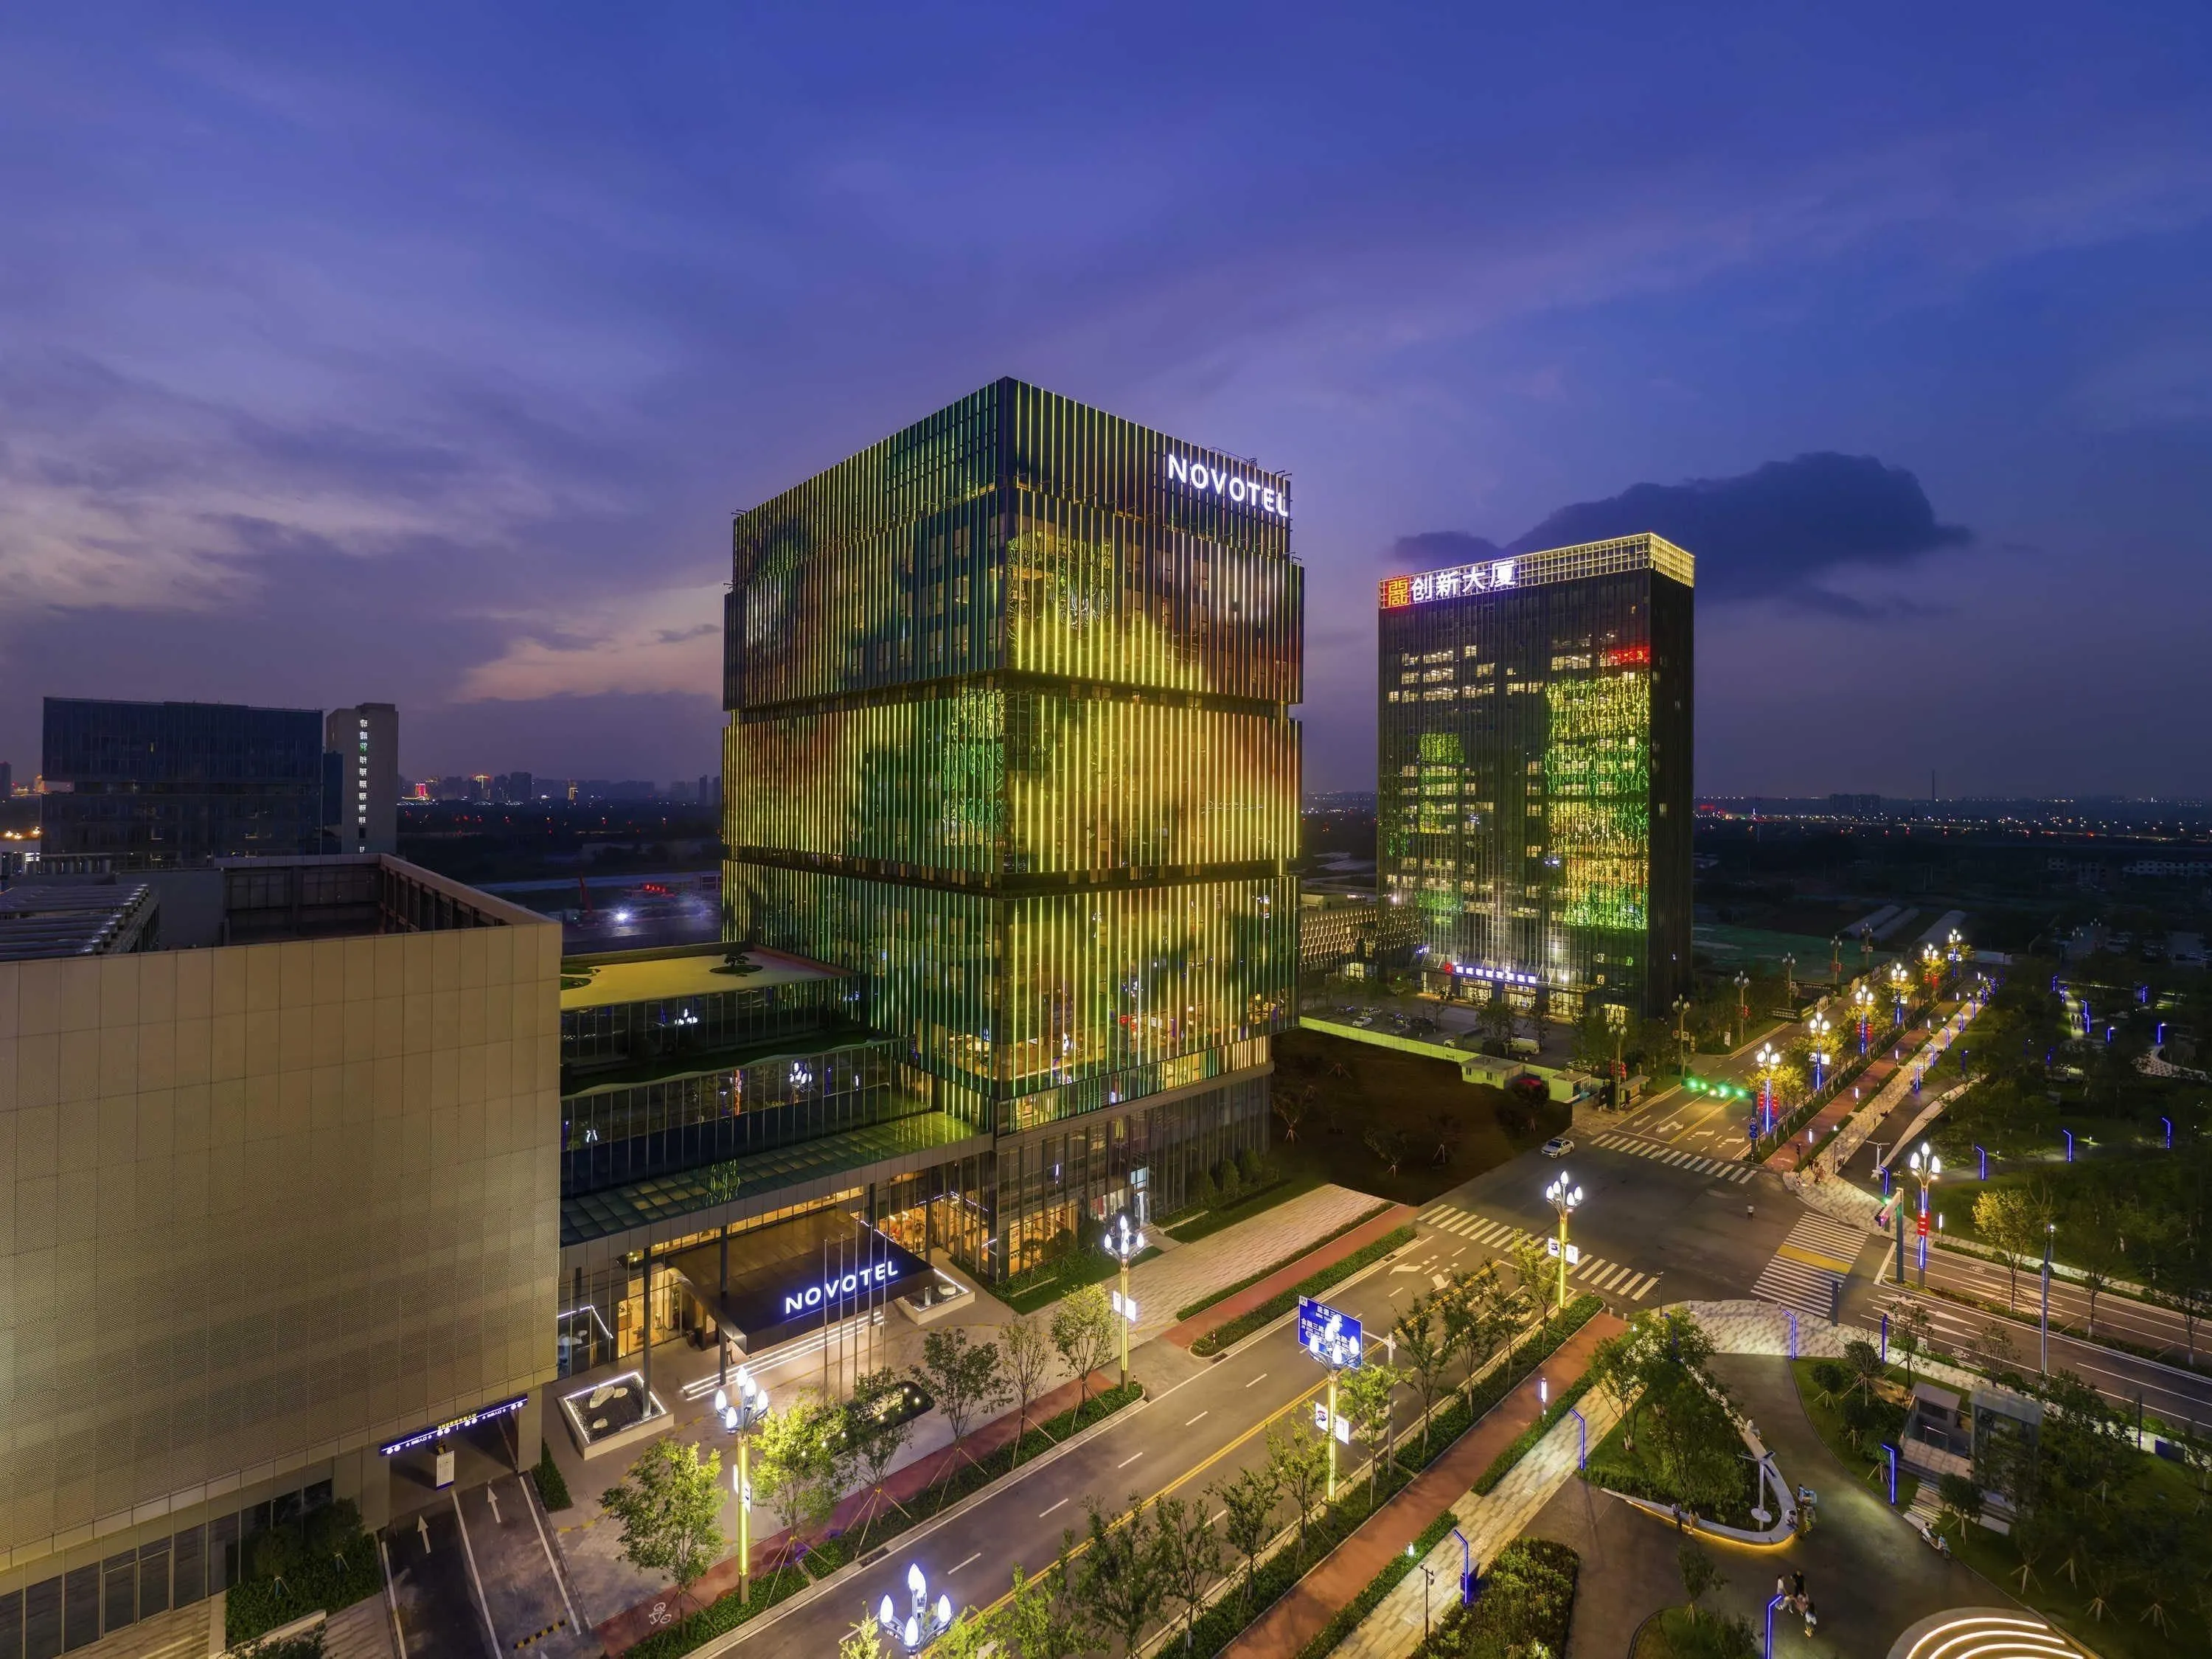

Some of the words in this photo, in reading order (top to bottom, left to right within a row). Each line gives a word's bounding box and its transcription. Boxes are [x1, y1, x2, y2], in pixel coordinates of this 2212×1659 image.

[1169, 453, 1288, 517] NOVOTEL
[1411, 559, 1517, 602] 创新大厦
[785, 1261, 898, 1315] NOVOTEL
